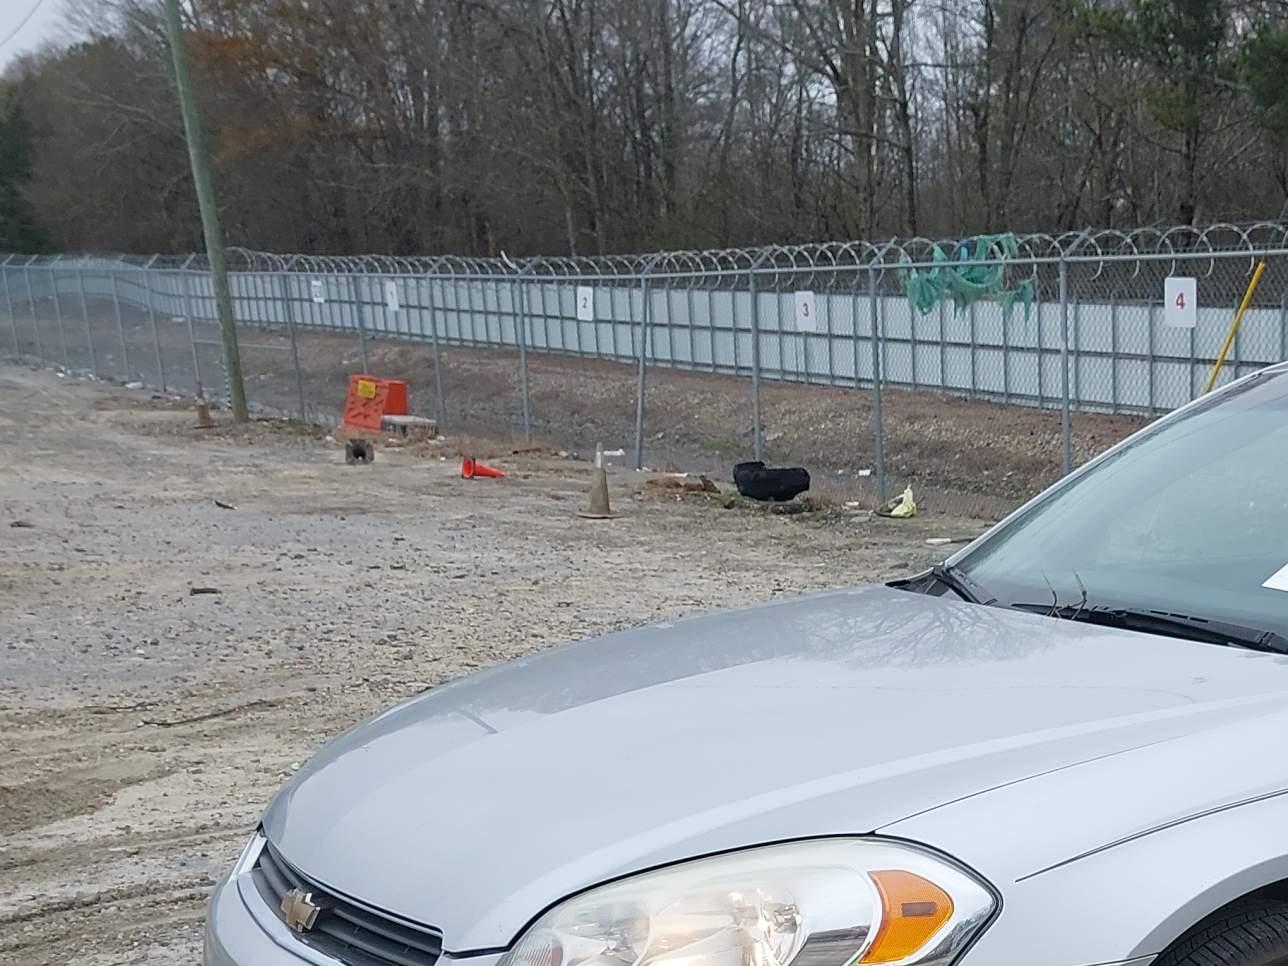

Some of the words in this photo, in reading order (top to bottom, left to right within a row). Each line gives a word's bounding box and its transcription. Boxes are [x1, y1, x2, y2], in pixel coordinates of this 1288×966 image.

[582, 296, 588, 309] 2
[1176, 292, 1186, 310] 4
[802, 302, 809, 318] 3
